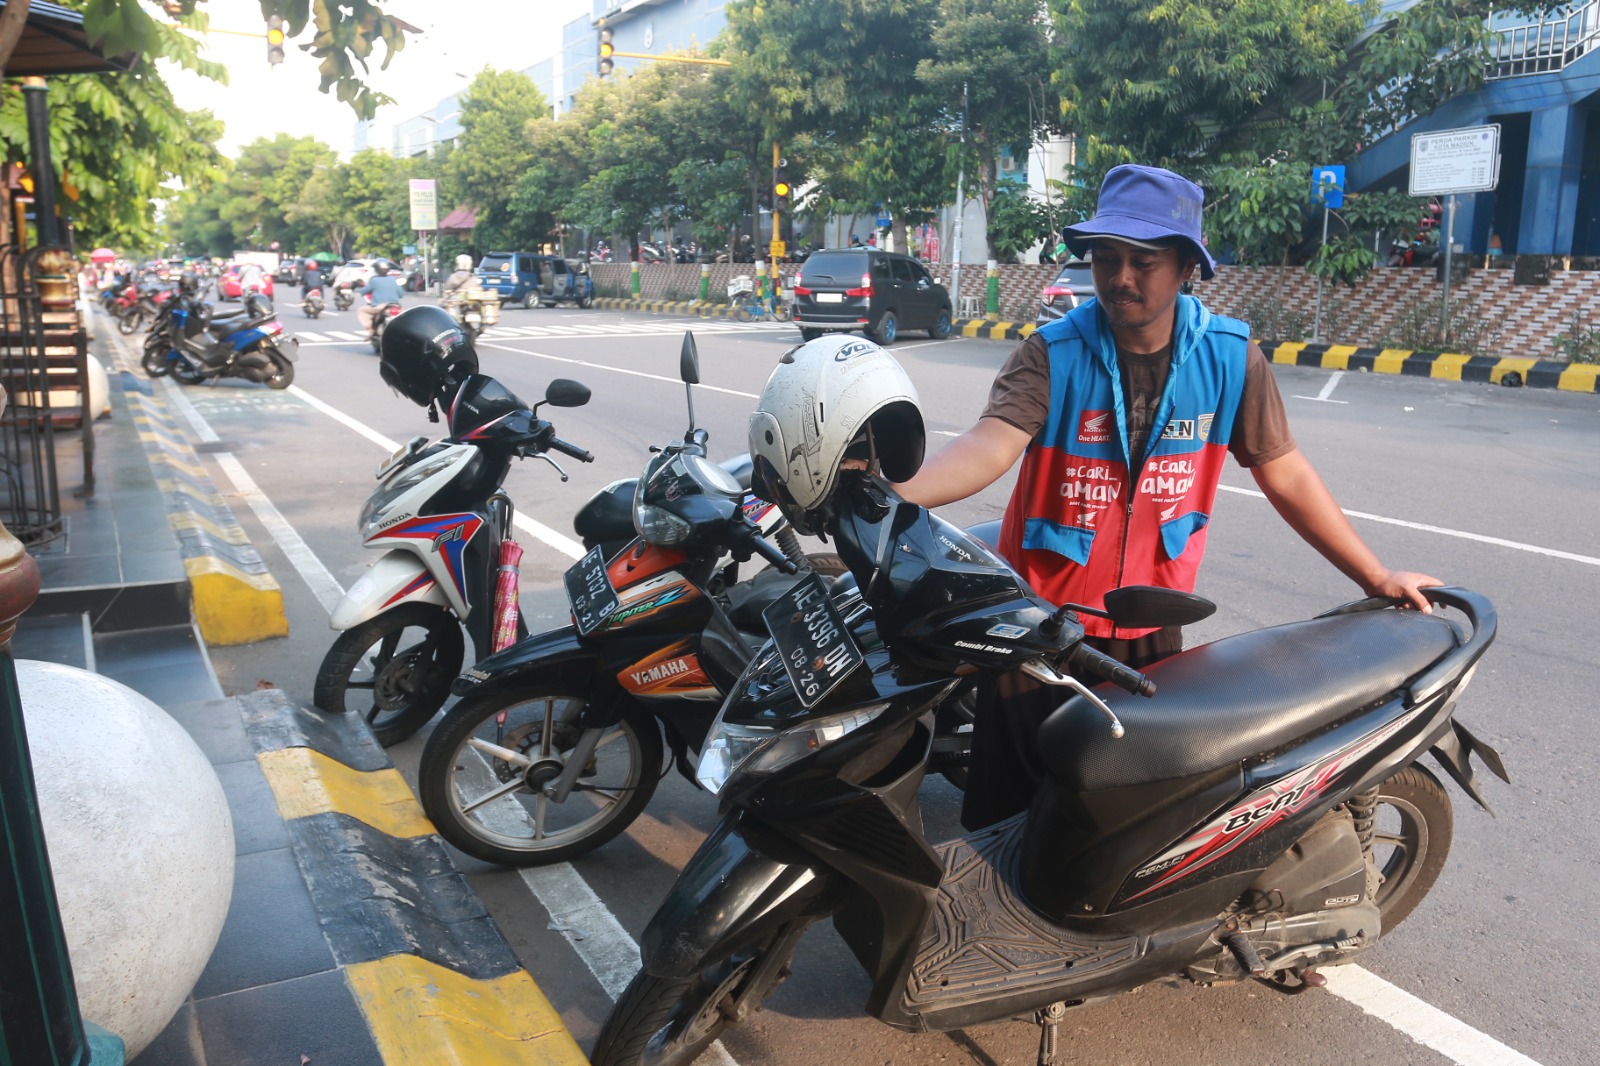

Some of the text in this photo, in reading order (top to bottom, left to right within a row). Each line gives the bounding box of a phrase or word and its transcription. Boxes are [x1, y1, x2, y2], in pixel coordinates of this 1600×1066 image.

[1319, 170, 1337, 198] P
[378, 512, 412, 530] HONDA
[431, 524, 465, 553] FI
[939, 535, 972, 561] HONDA
[598, 600, 616, 618] B
[791, 581, 820, 610] AE
[803, 603, 840, 649] 3396
[823, 641, 853, 678] DN
[954, 640, 1013, 654] Combi Brake
[631, 659, 689, 686] YAMAHA
[1134, 853, 1186, 879] PGM-FI
